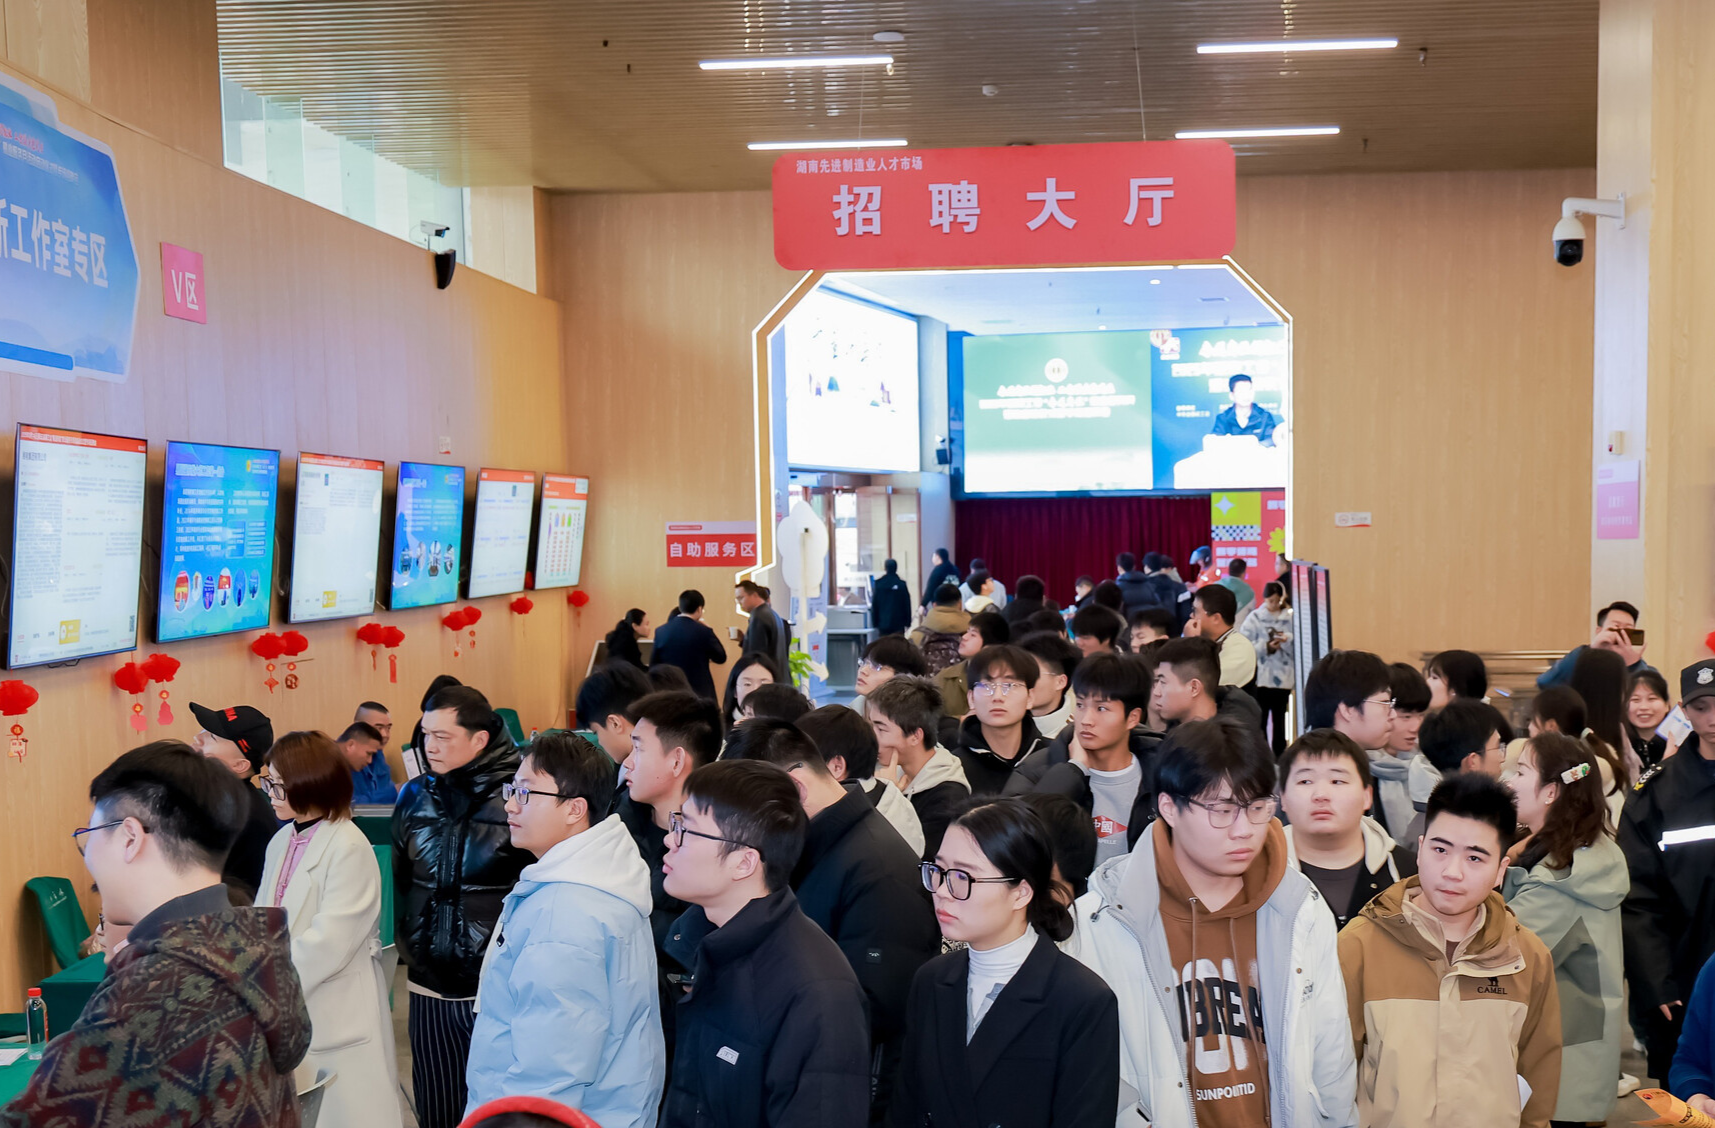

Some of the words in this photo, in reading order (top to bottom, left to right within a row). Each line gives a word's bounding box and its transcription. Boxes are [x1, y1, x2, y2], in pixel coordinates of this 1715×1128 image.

[796, 156, 923, 174] 湖南先进制造业人才市场
[832, 176, 1175, 236] 招聘大厅
[171, 269, 199, 311] V区
[669, 541, 755, 558] 自助服务区
[1477, 986, 1508, 995] CAMEL
